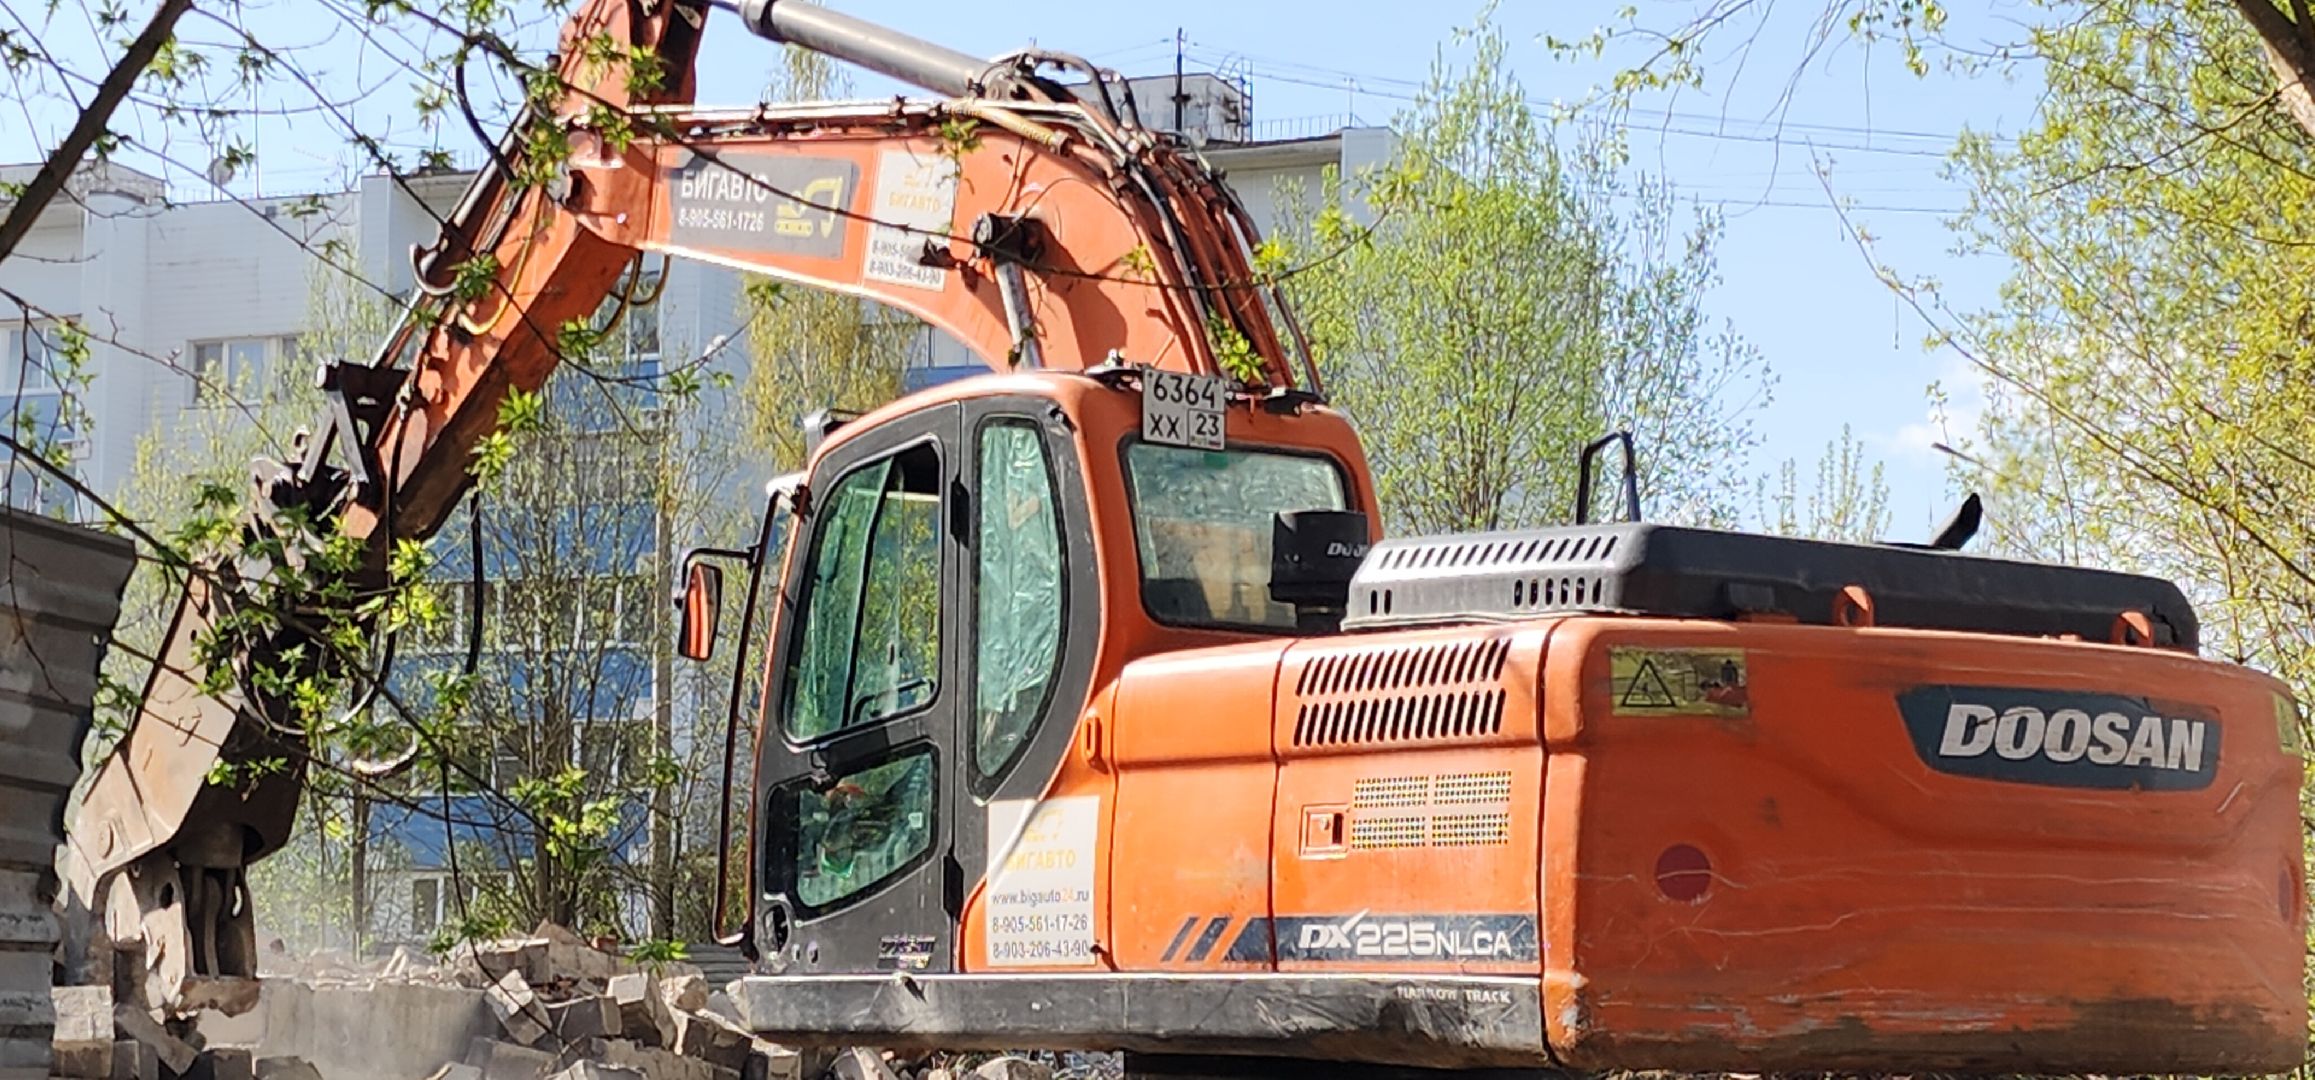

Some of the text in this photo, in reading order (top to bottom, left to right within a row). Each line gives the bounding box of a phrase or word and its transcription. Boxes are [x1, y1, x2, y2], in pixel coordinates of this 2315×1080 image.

[681, 170, 768, 203] БИГАВТО
[1153, 376, 1216, 409] 6364
[1196, 412, 1220, 437] 23
[1938, 703, 2205, 772] DOOSAN
[992, 913, 1088, 933] 8-905-561-17-26
[992, 939, 1089, 960] 8-903-206-43-90
[1465, 988, 1512, 1004] TRACK
